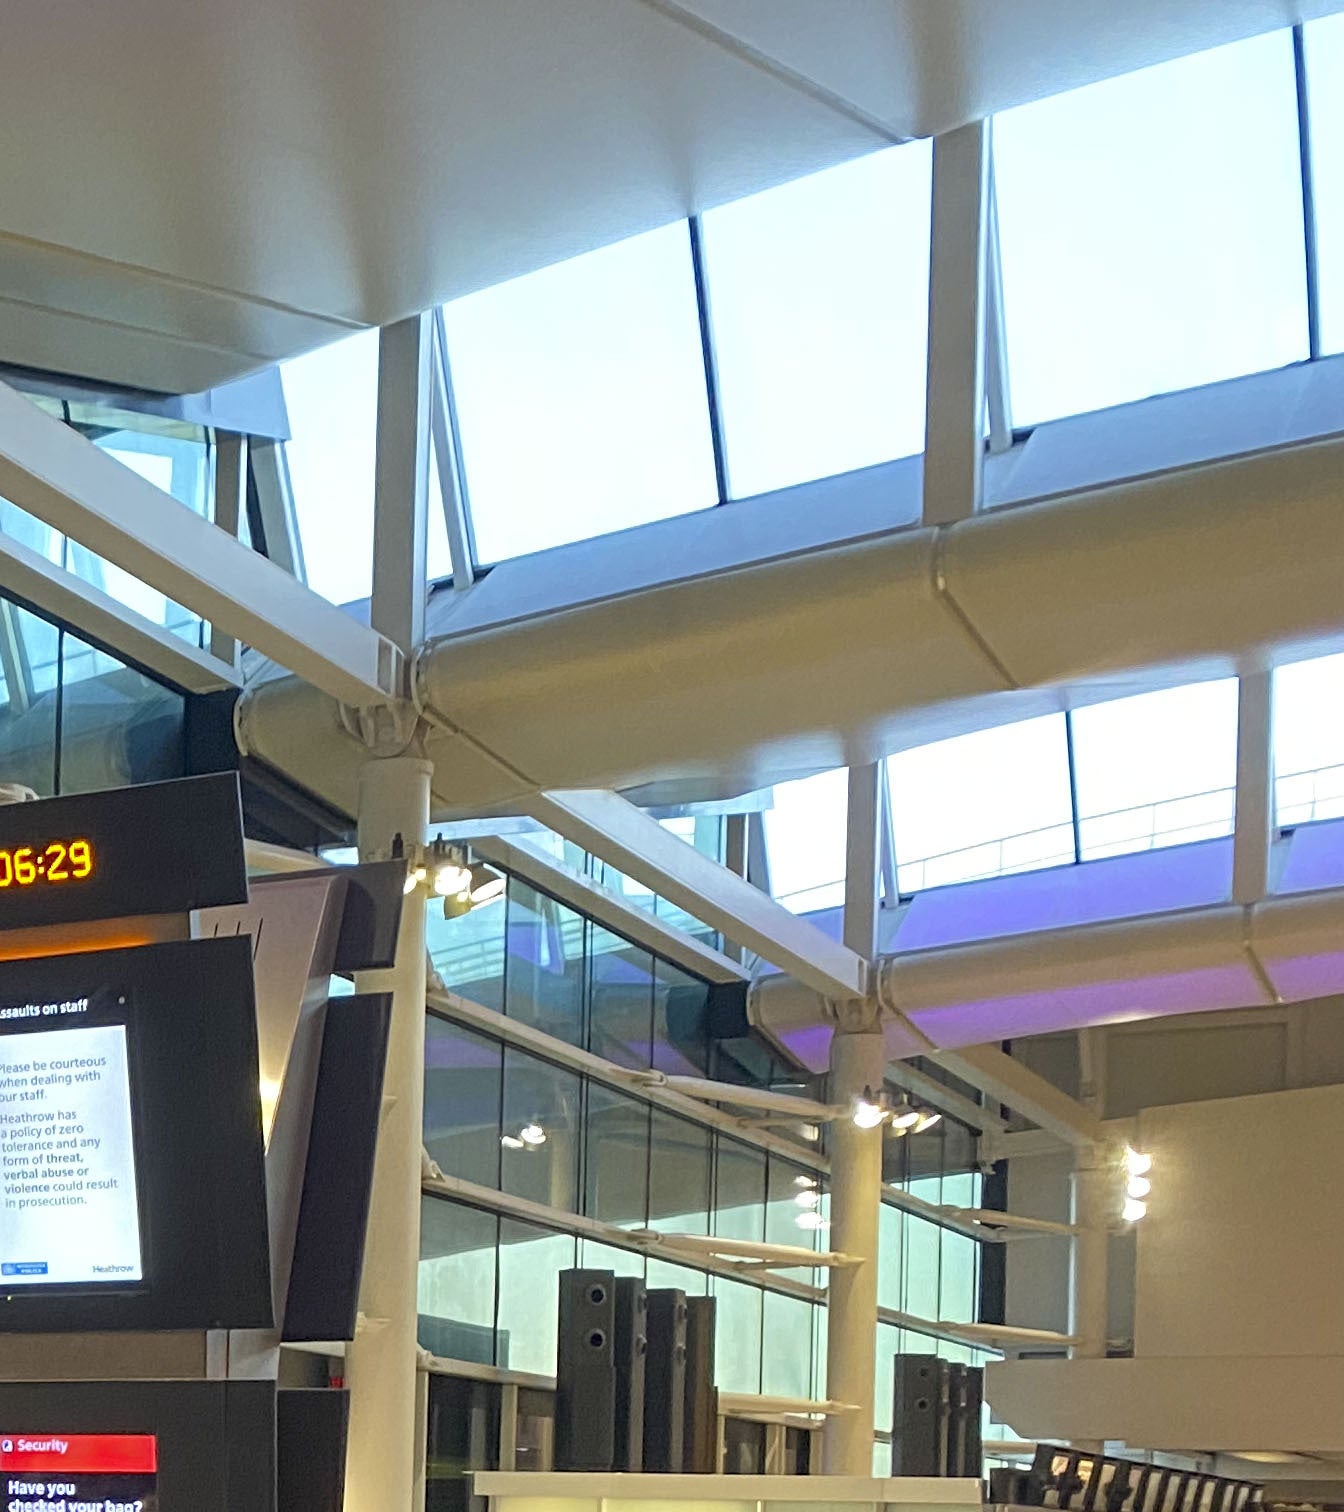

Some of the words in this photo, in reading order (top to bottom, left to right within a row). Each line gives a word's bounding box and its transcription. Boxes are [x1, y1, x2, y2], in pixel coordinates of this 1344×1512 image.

[42, 1004, 57, 1016] on
[61, 999, 88, 1013] staff
[33, 1060, 47, 1072] be
[49, 1056, 107, 1071] courteous
[30, 1073, 72, 1086] dealing
[74, 1070, 101, 1082] with
[19, 1089, 47, 1101] staff.
[0, 1111, 55, 1125] Heathrow
[57, 1110, 77, 1121] has
[0, 1130, 8, 1139] a
[10, 1125, 42, 1140] policy
[44, 1124, 57, 1136] of
[59, 1124, 84, 1135] zero
[1, 1139, 54, 1153] tolerance
[56, 1138, 77, 1150] and
[80, 1138, 101, 1150] any
[2, 1155, 29, 1166] form
[31, 1154, 43, 1165] of
[46, 1153, 84, 1164] threat,
[3, 1168, 38, 1181] verbal
[41, 1167, 74, 1179] abuse
[76, 1167, 89, 1176] or
[4, 1181, 50, 1195] violence
[52, 1180, 83, 1192] could
[86, 1178, 119, 1190] result
[5, 1197, 16, 1208] in
[18, 1195, 87, 1210] prosecution.
[92, 1264, 134, 1273] Heathrow
[17, 1439, 68, 1454] Security
[8, 1480, 45, 1496] Have
[47, 1483, 76, 1498] you
